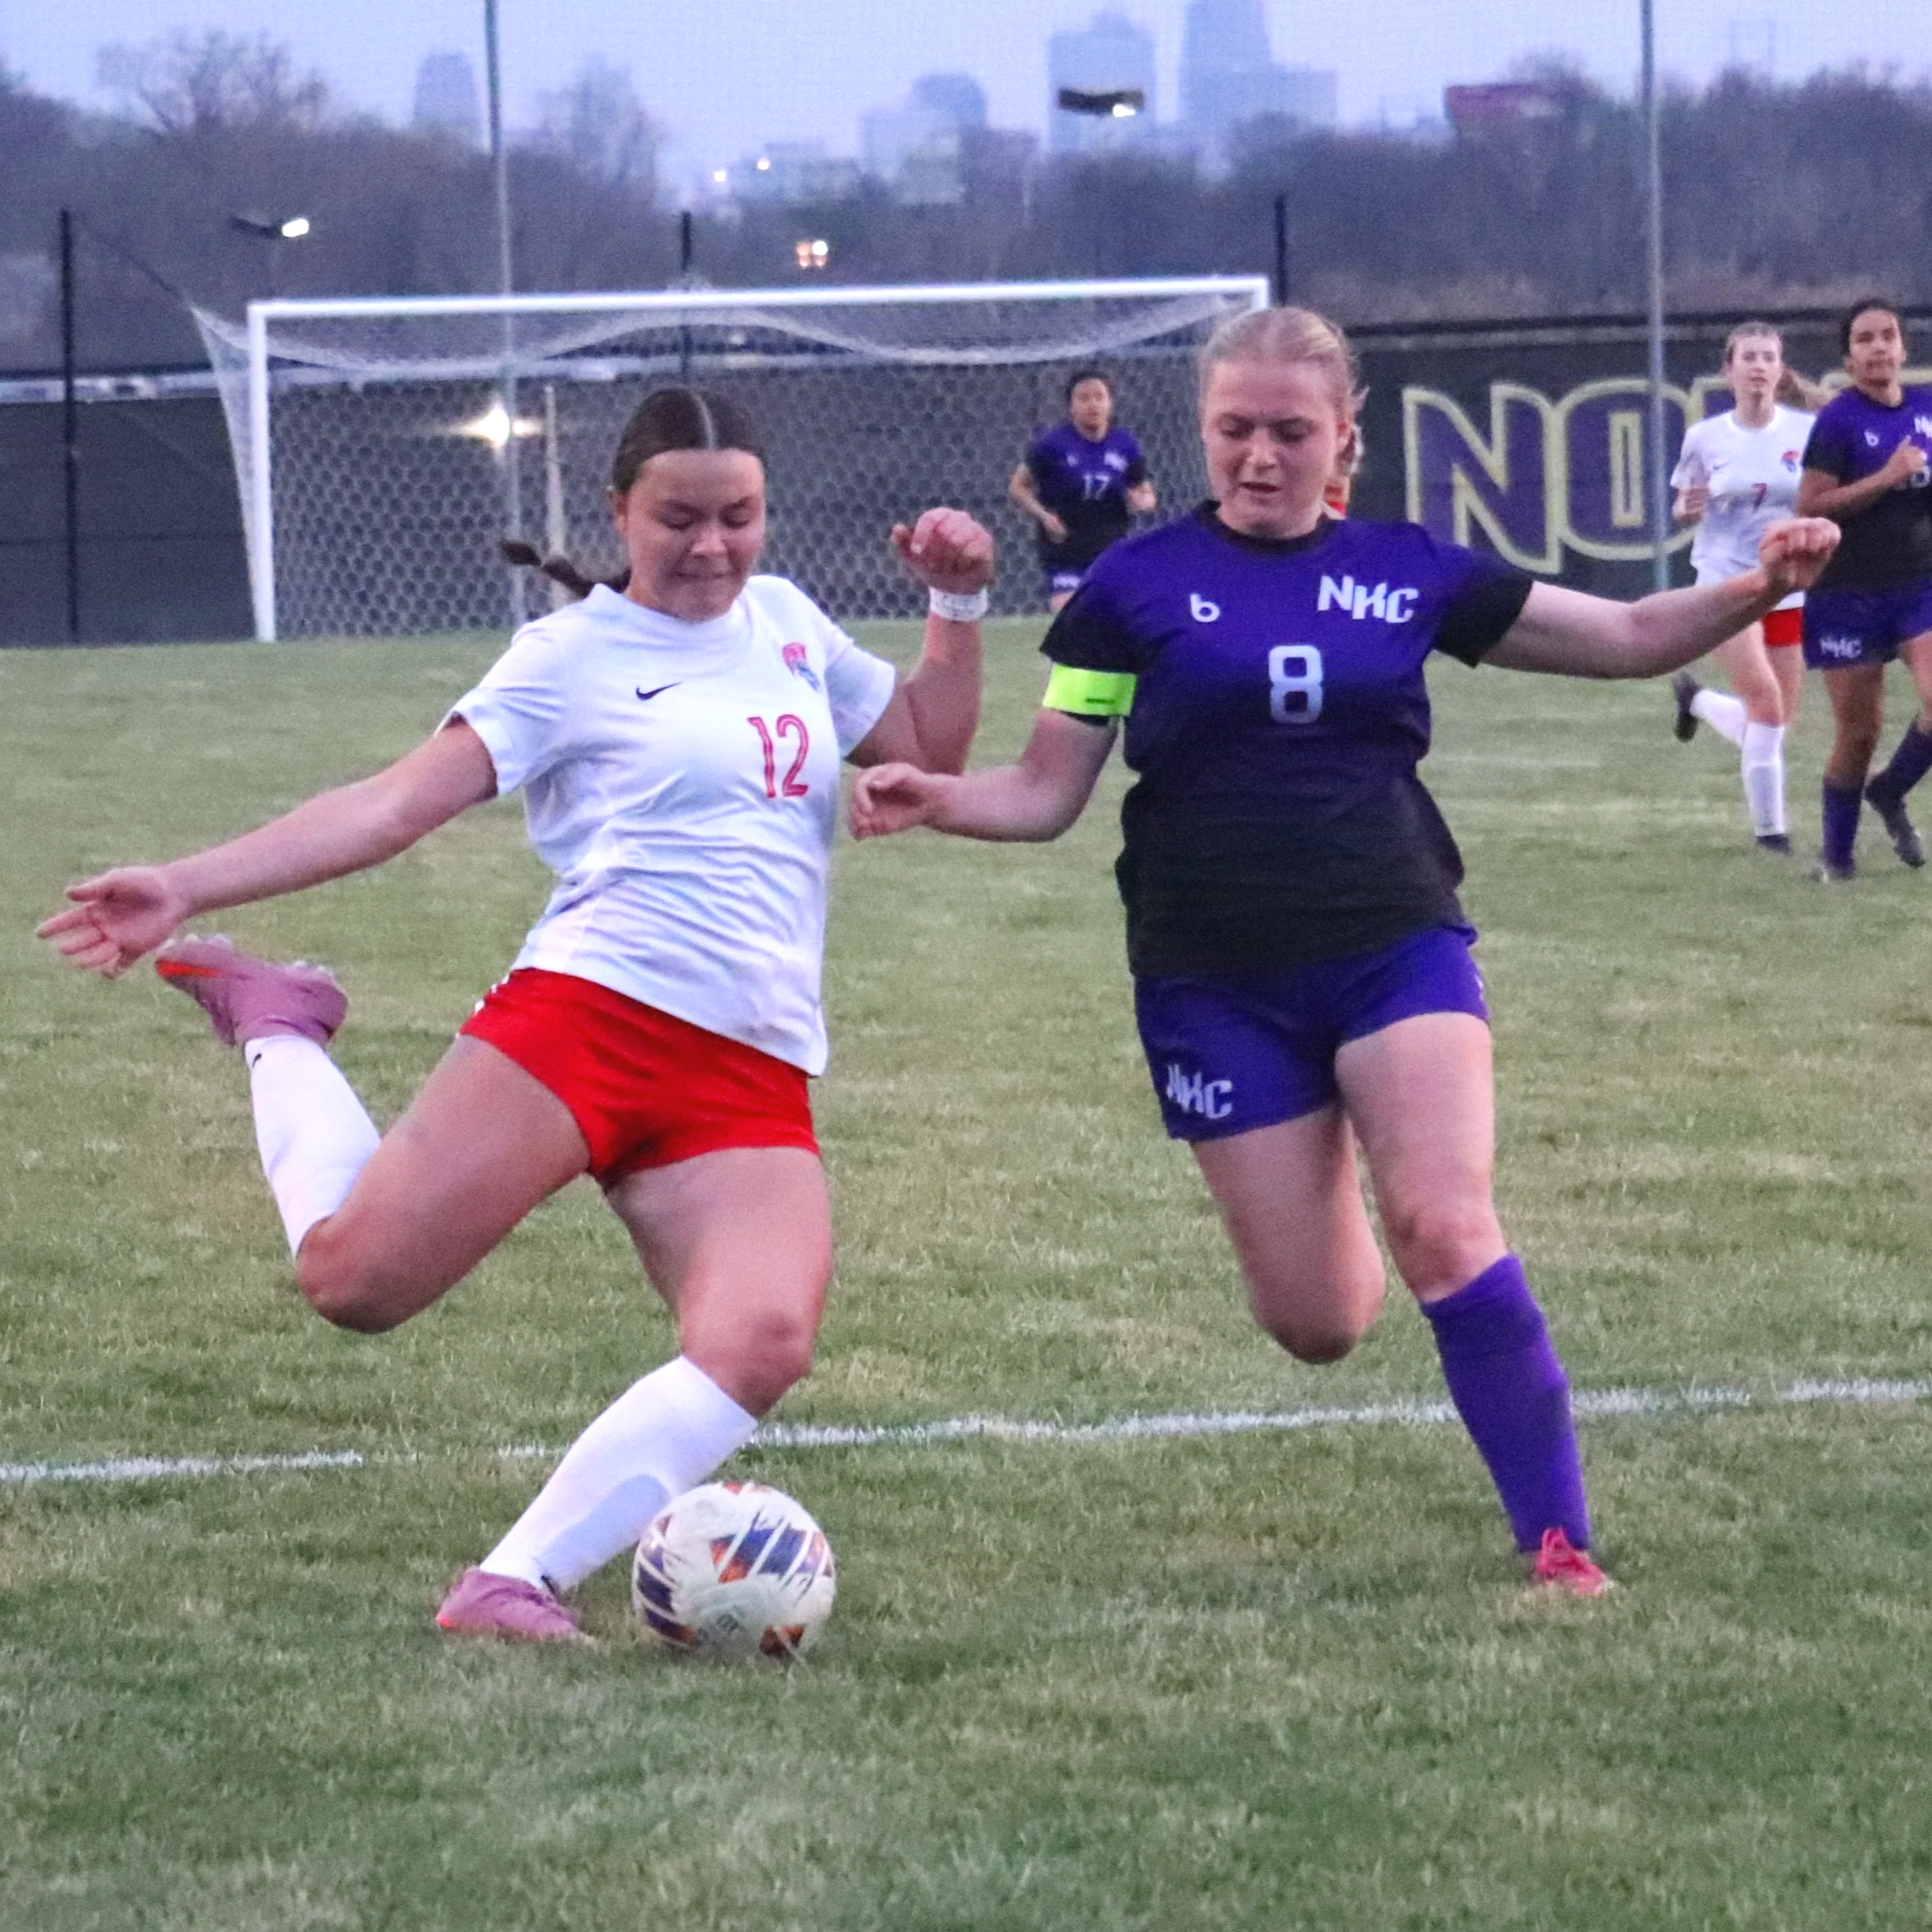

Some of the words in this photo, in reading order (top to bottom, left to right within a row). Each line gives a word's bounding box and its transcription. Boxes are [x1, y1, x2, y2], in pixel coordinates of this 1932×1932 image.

[1751, 483, 1768, 514] 7
[1317, 574, 1419, 623] NKC
[1268, 644, 1323, 724] 8
[746, 713, 809, 798] 12
